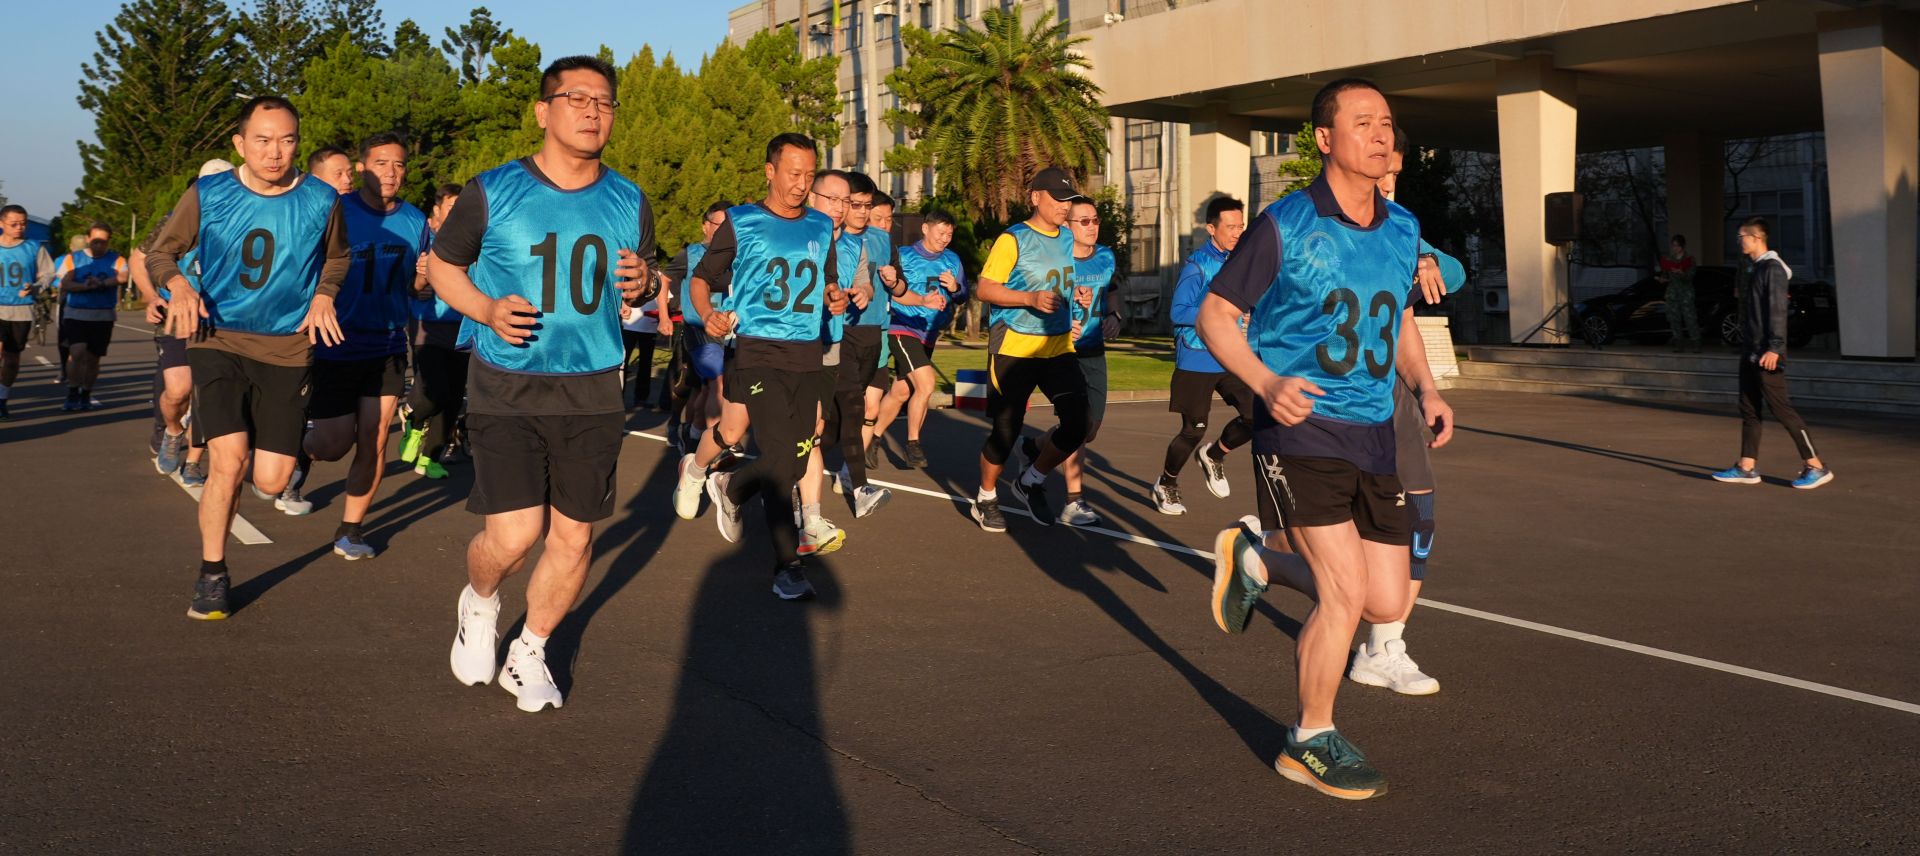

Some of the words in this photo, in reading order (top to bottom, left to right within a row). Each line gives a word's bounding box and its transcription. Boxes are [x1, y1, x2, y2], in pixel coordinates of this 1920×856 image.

[0, 261, 23, 288] 19
[240, 228, 275, 291] 9
[356, 242, 409, 295] 17
[530, 232, 608, 316] 10
[763, 256, 818, 314] 32
[1315, 287, 1398, 380] 33
[1301, 750, 1329, 777] HOKA
